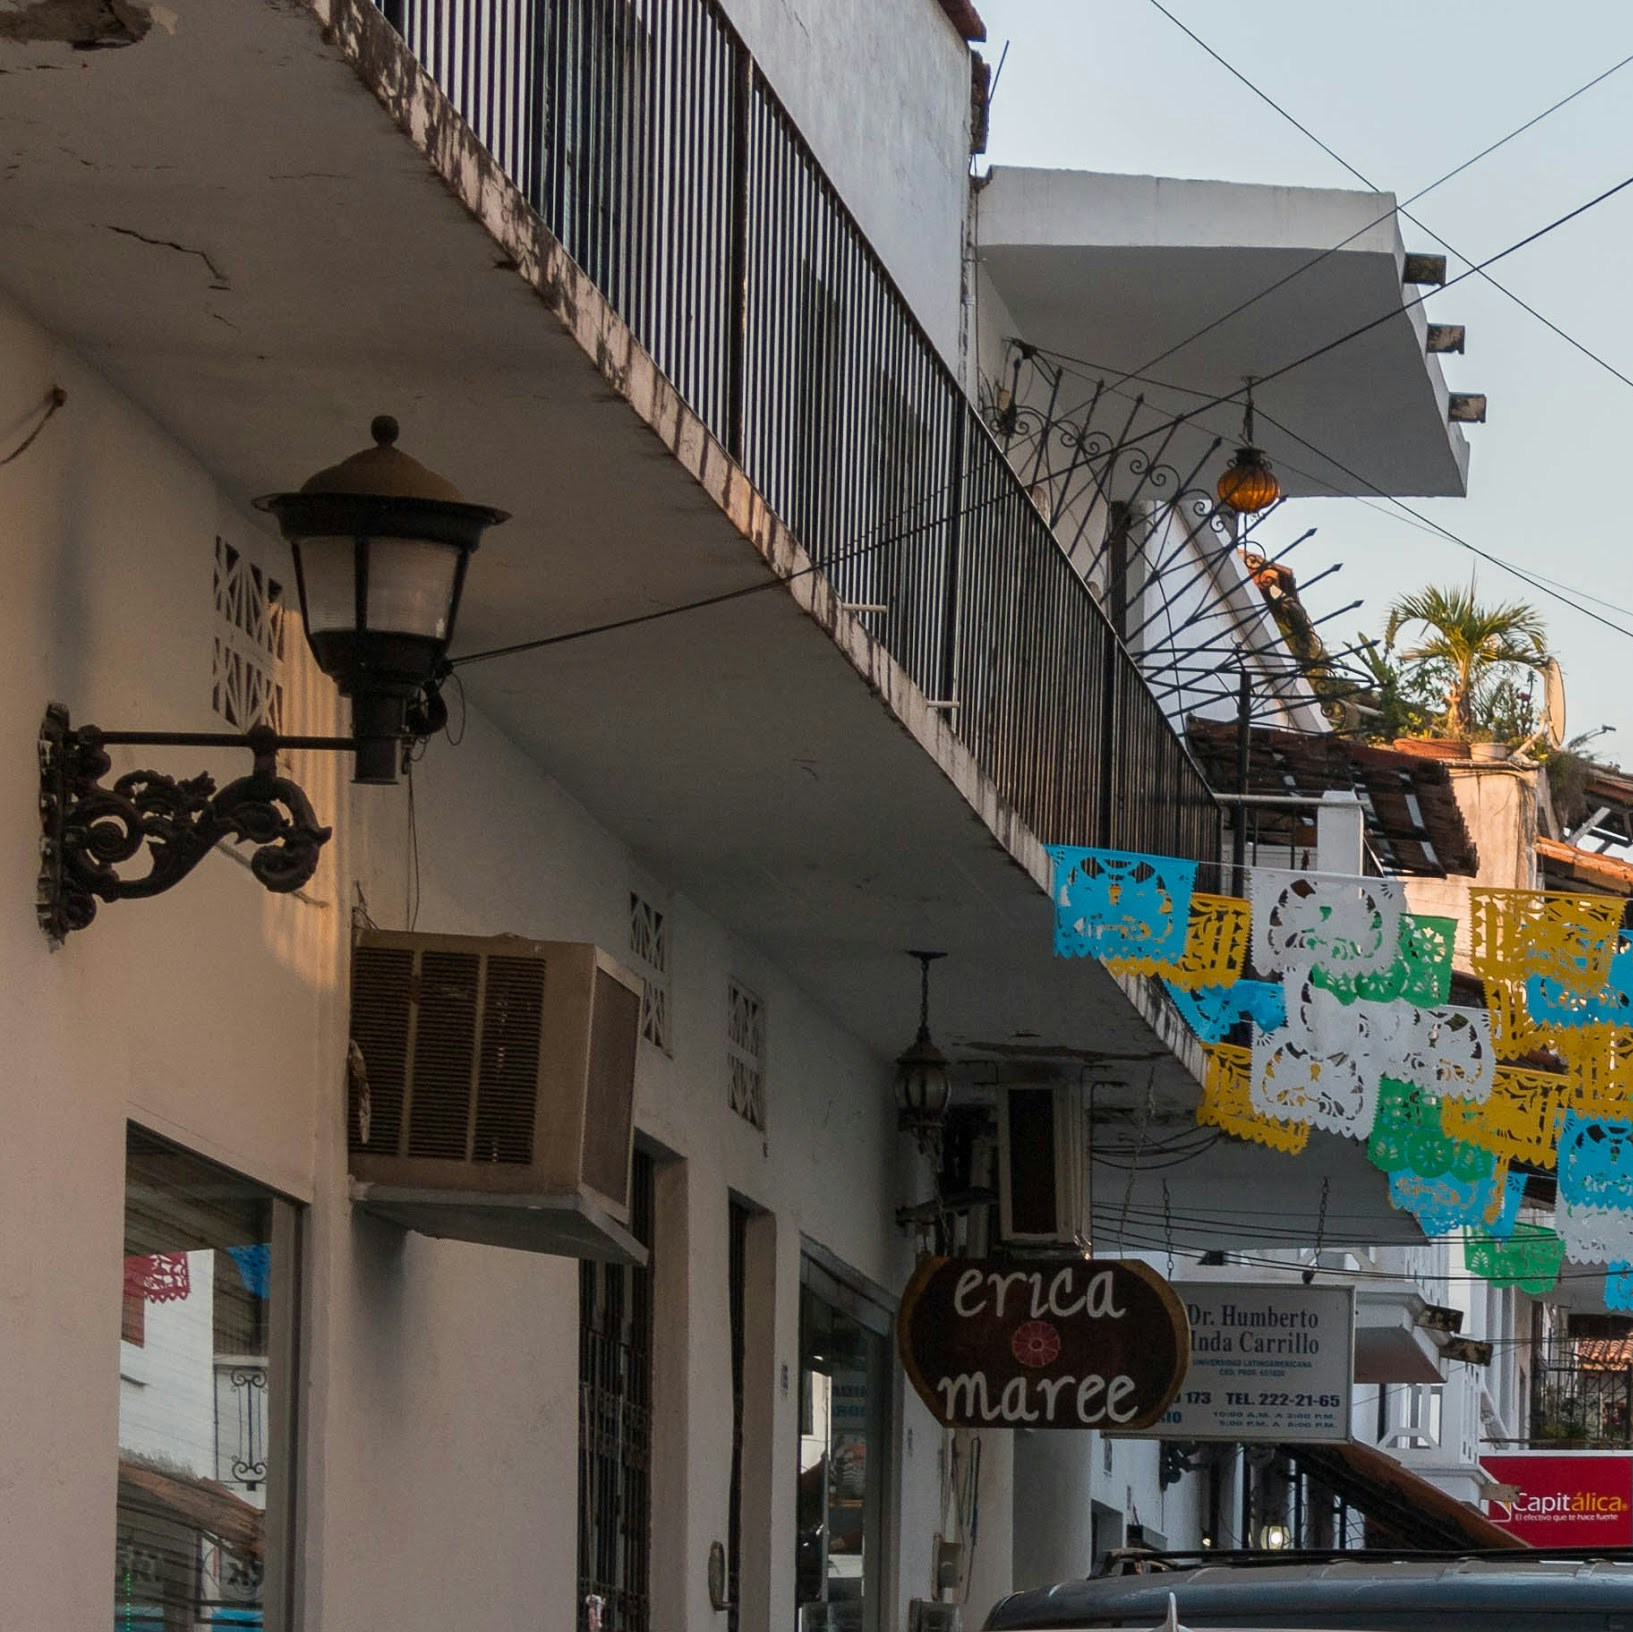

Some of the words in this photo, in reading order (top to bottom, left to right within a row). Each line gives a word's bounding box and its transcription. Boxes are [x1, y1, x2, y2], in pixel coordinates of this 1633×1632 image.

[954, 1267, 1127, 1319] erica
[1188, 1304, 1215, 1327] Dr.
[1222, 1305, 1320, 1329] Humberto
[1239, 1331, 1320, 1355] Carrillo
[937, 1371, 1140, 1424] maree
[1186, 1391, 1212, 1405] 173
[1225, 1392, 1256, 1406] TEL.
[1259, 1393, 1341, 1408] 222-21-65
[1553, 1514, 1568, 1523] que
